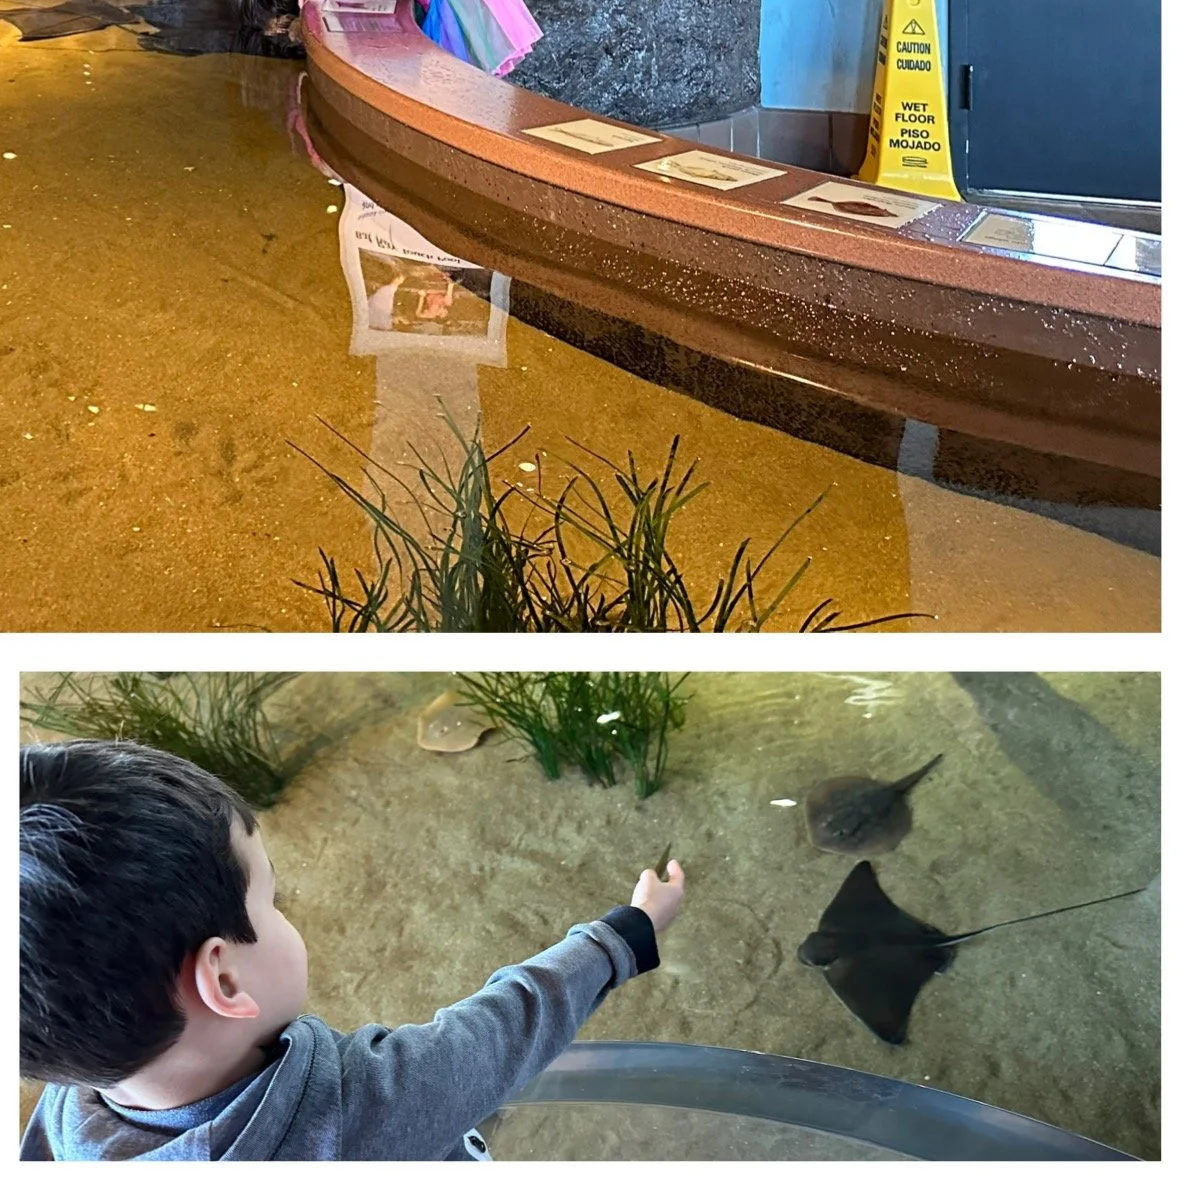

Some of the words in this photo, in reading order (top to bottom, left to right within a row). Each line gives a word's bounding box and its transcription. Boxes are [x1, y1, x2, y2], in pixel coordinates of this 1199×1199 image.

[896, 41, 931, 55] CAUTION
[896, 58, 932, 72] CUIDADO
[901, 101, 928, 113] WET
[895, 112, 936, 125] FLOOR
[900, 128, 930, 140] PISO
[889, 138, 941, 152] MOJADO
